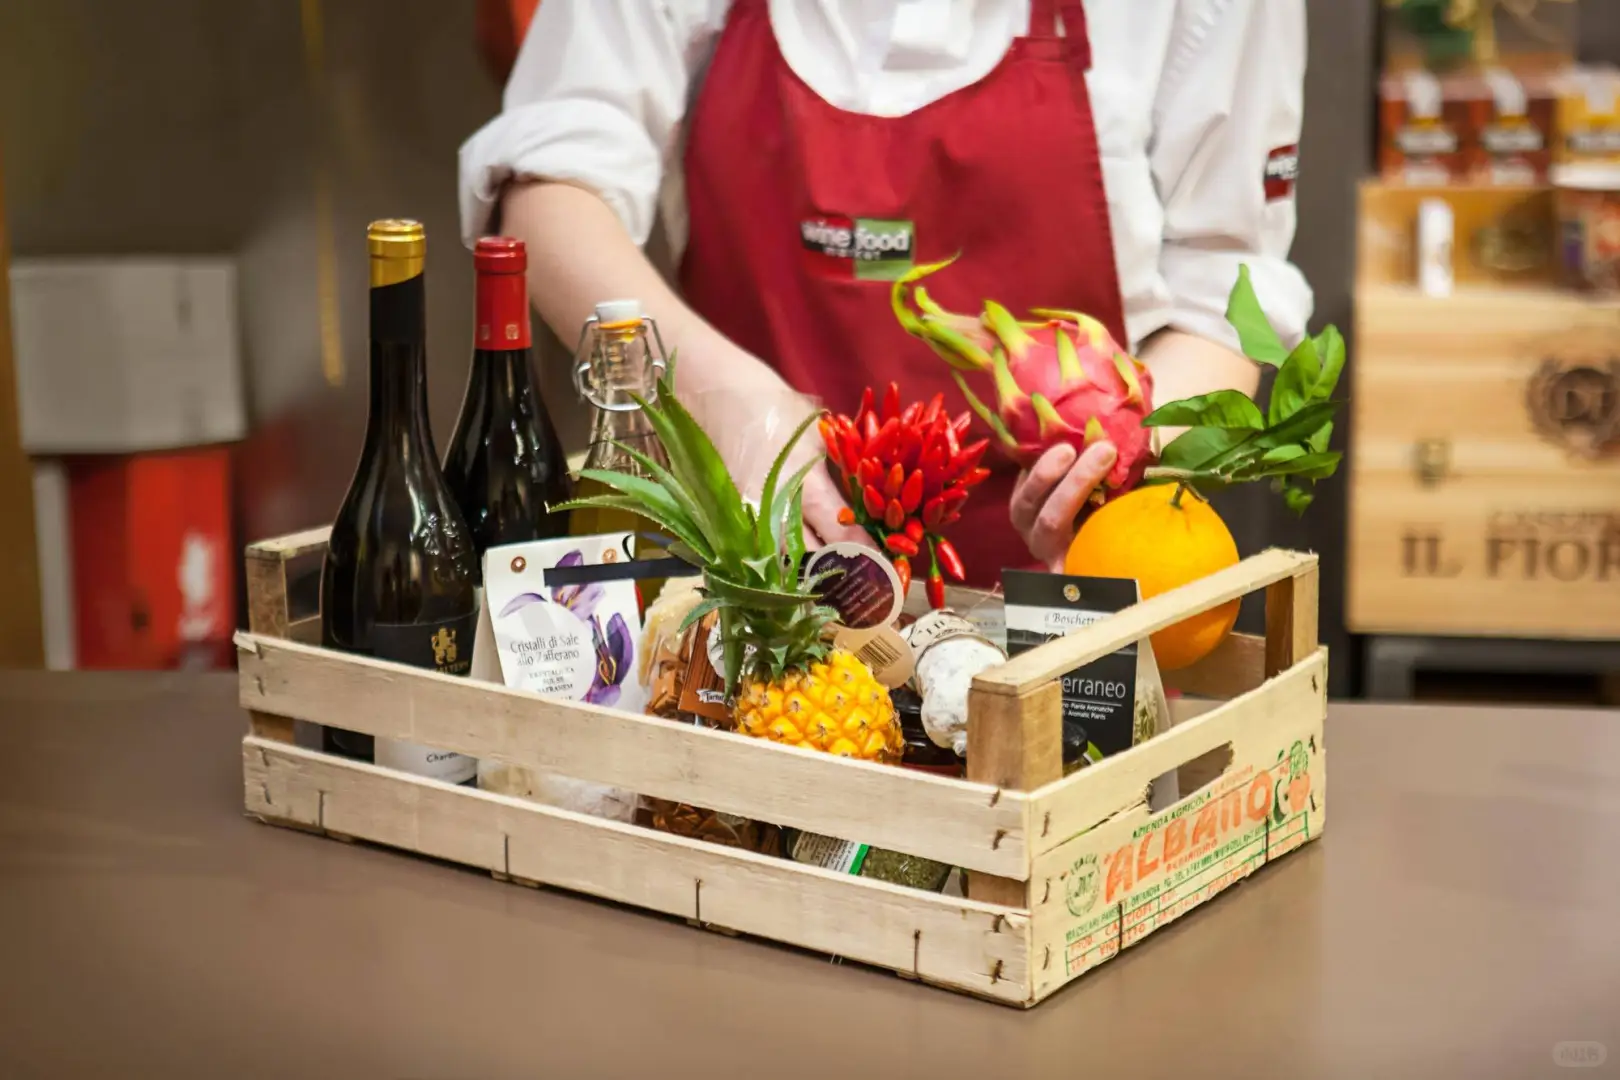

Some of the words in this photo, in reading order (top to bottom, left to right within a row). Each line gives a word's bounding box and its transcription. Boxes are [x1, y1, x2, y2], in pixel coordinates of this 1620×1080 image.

[802, 221, 850, 248] wine
[855, 226, 909, 250] food
[510, 637, 546, 653] Cristalli
[549, 635, 558, 648] di
[1062, 676, 1126, 699] erraneo
[1171, 791, 1212, 819] AGRICOLA
[1104, 769, 1272, 905] ALBANO
